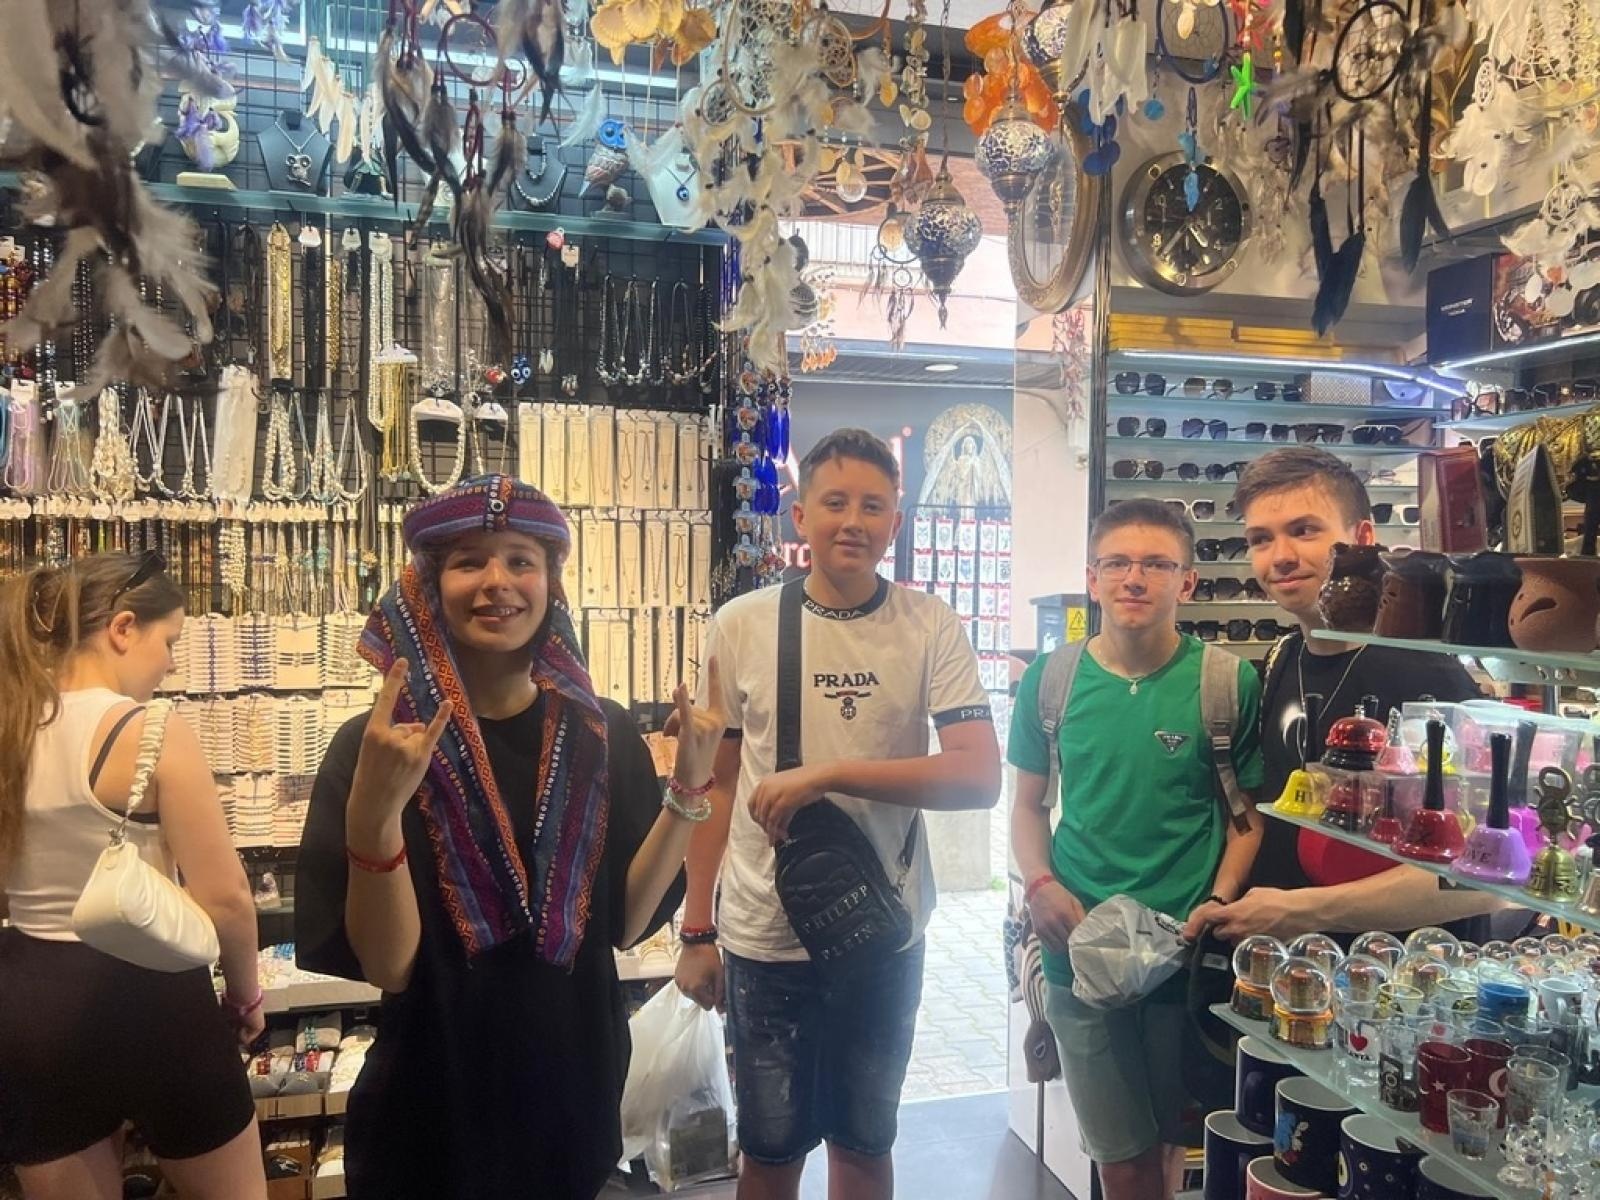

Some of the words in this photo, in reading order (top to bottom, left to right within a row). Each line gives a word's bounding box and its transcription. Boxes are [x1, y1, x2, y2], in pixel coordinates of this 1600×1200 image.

[804, 600, 865, 619] PRADA
[813, 672, 880, 688] PRADA
[804, 885, 867, 933] PHILIPP
